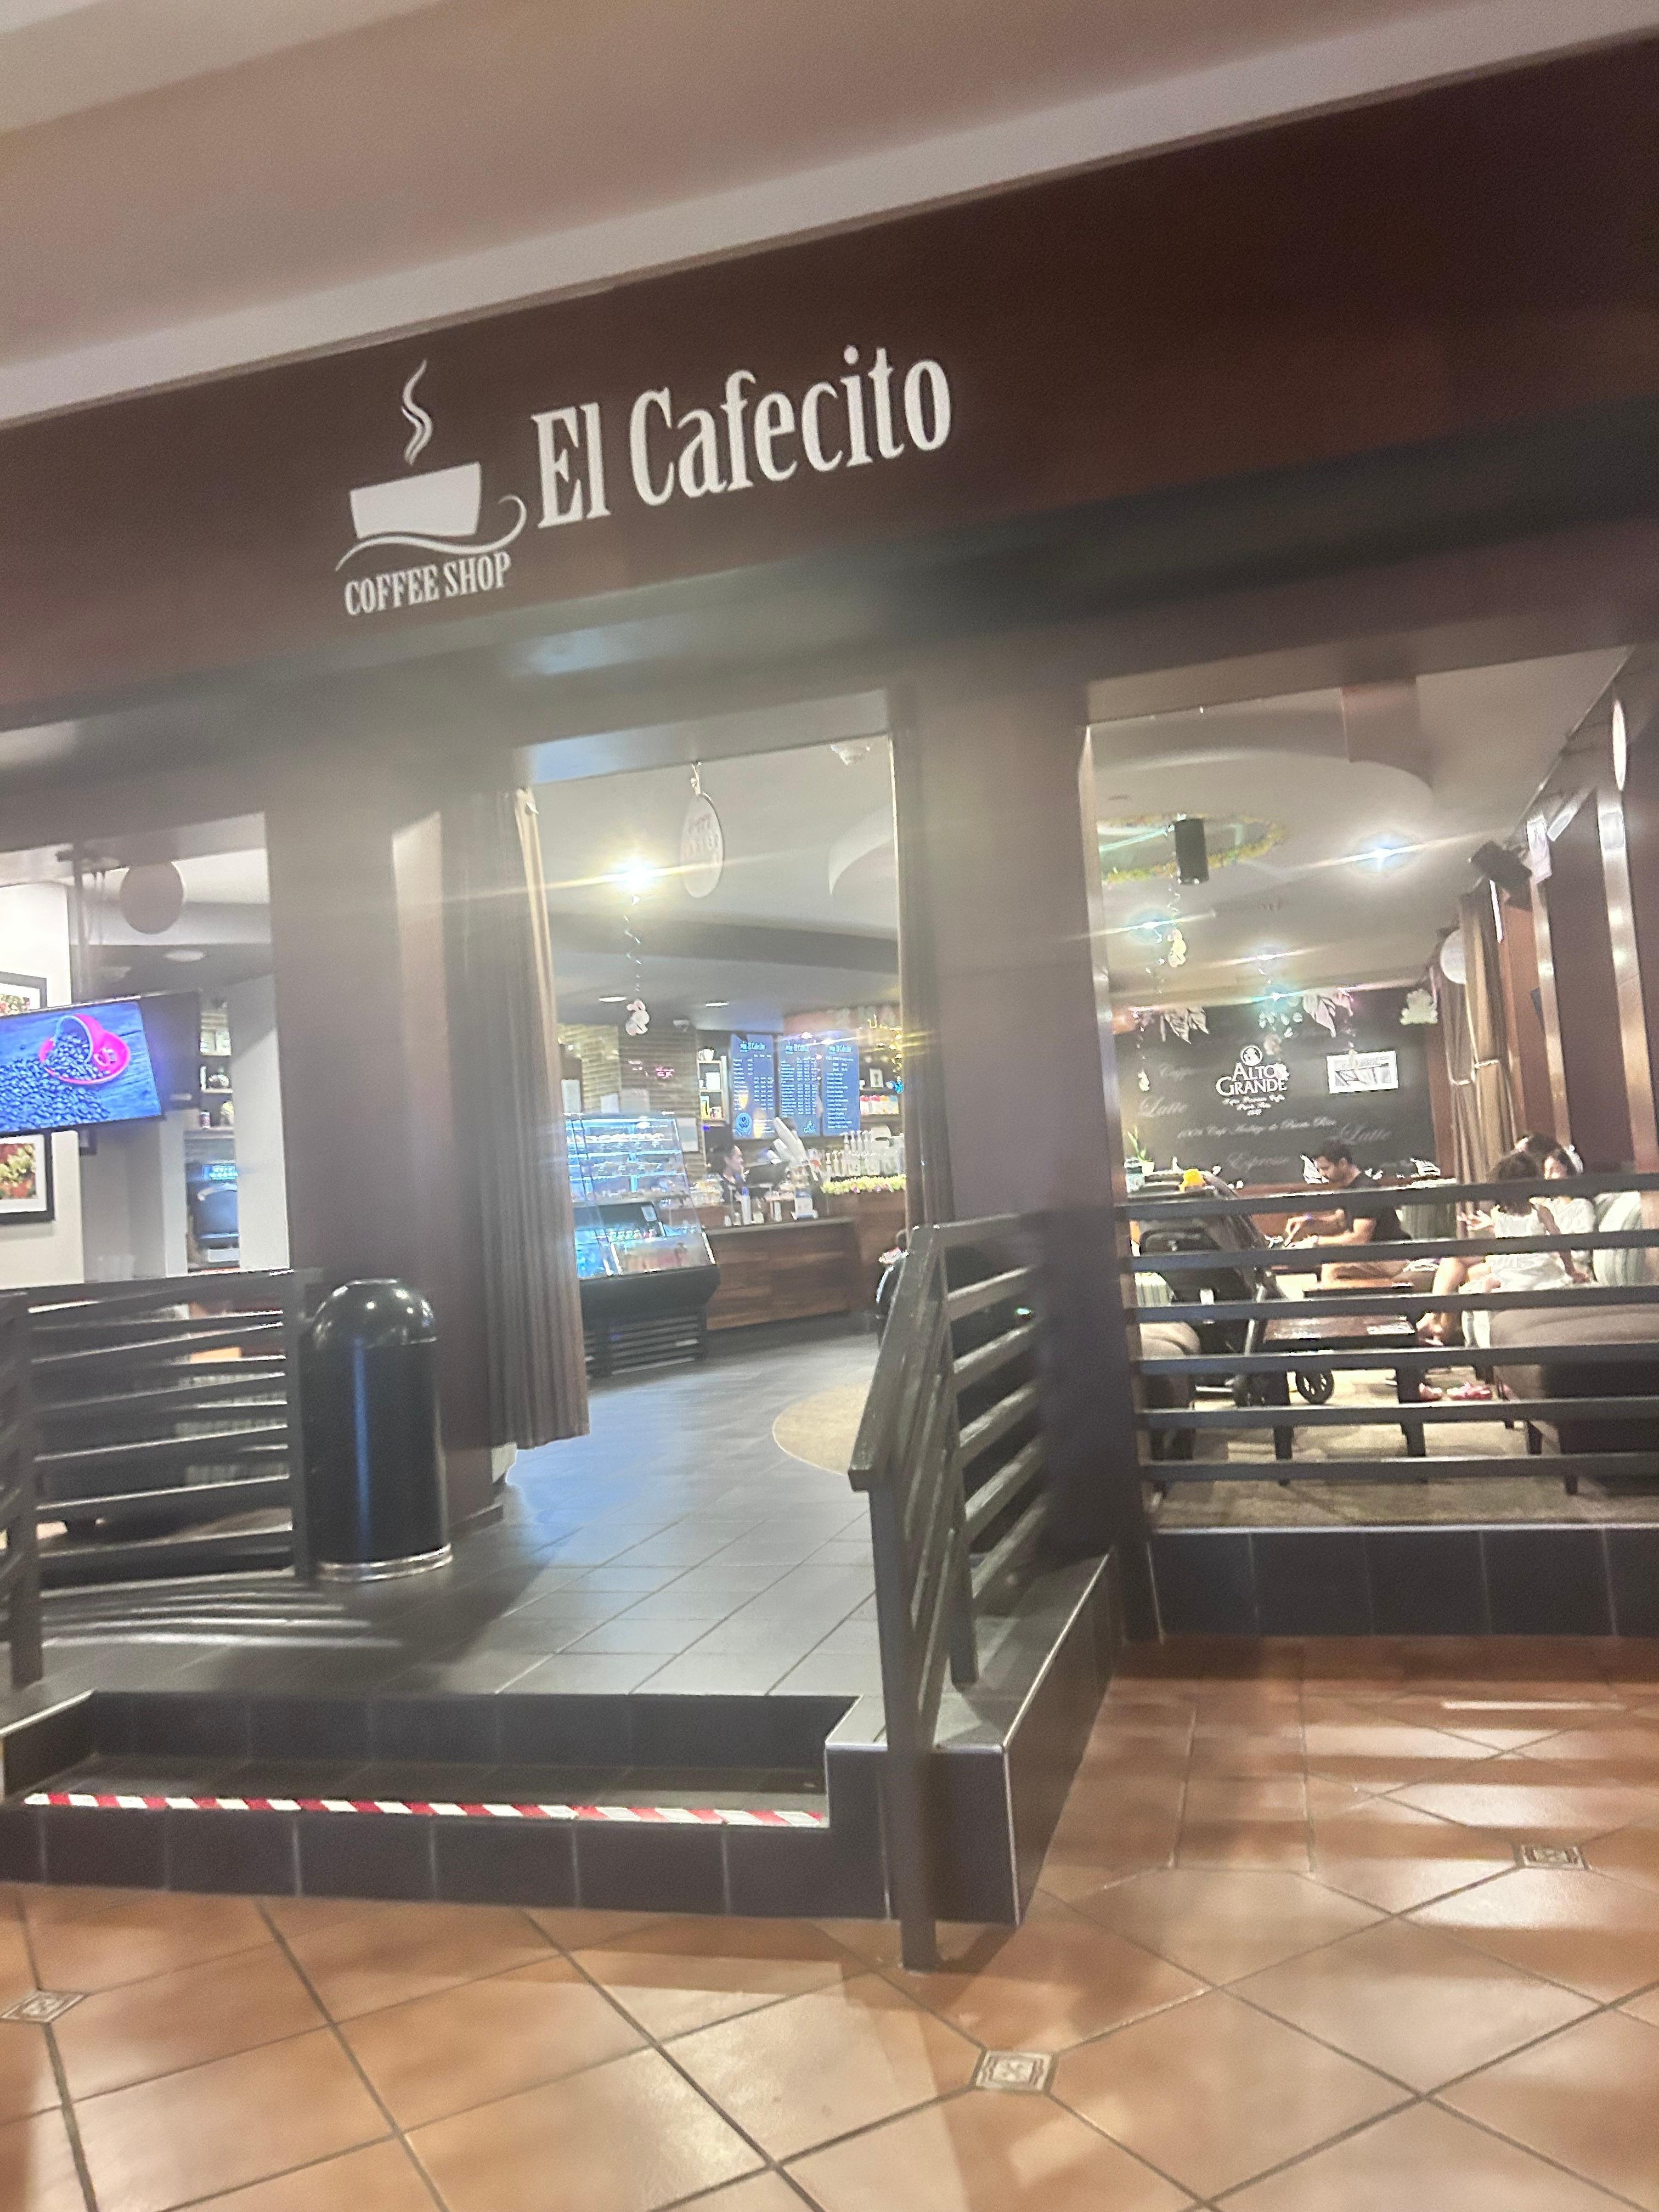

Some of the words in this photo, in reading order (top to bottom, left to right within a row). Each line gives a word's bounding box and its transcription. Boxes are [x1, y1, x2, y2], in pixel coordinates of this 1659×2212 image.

[531, 402, 612, 529] El
[630, 346, 951, 505] Cafecito
[345, 564, 439, 615] COFFEE
[443, 551, 511, 597] SHOP
[1216, 1076, 1287, 1096] GRANDE
[1232, 1062, 1276, 1082] ALTO
